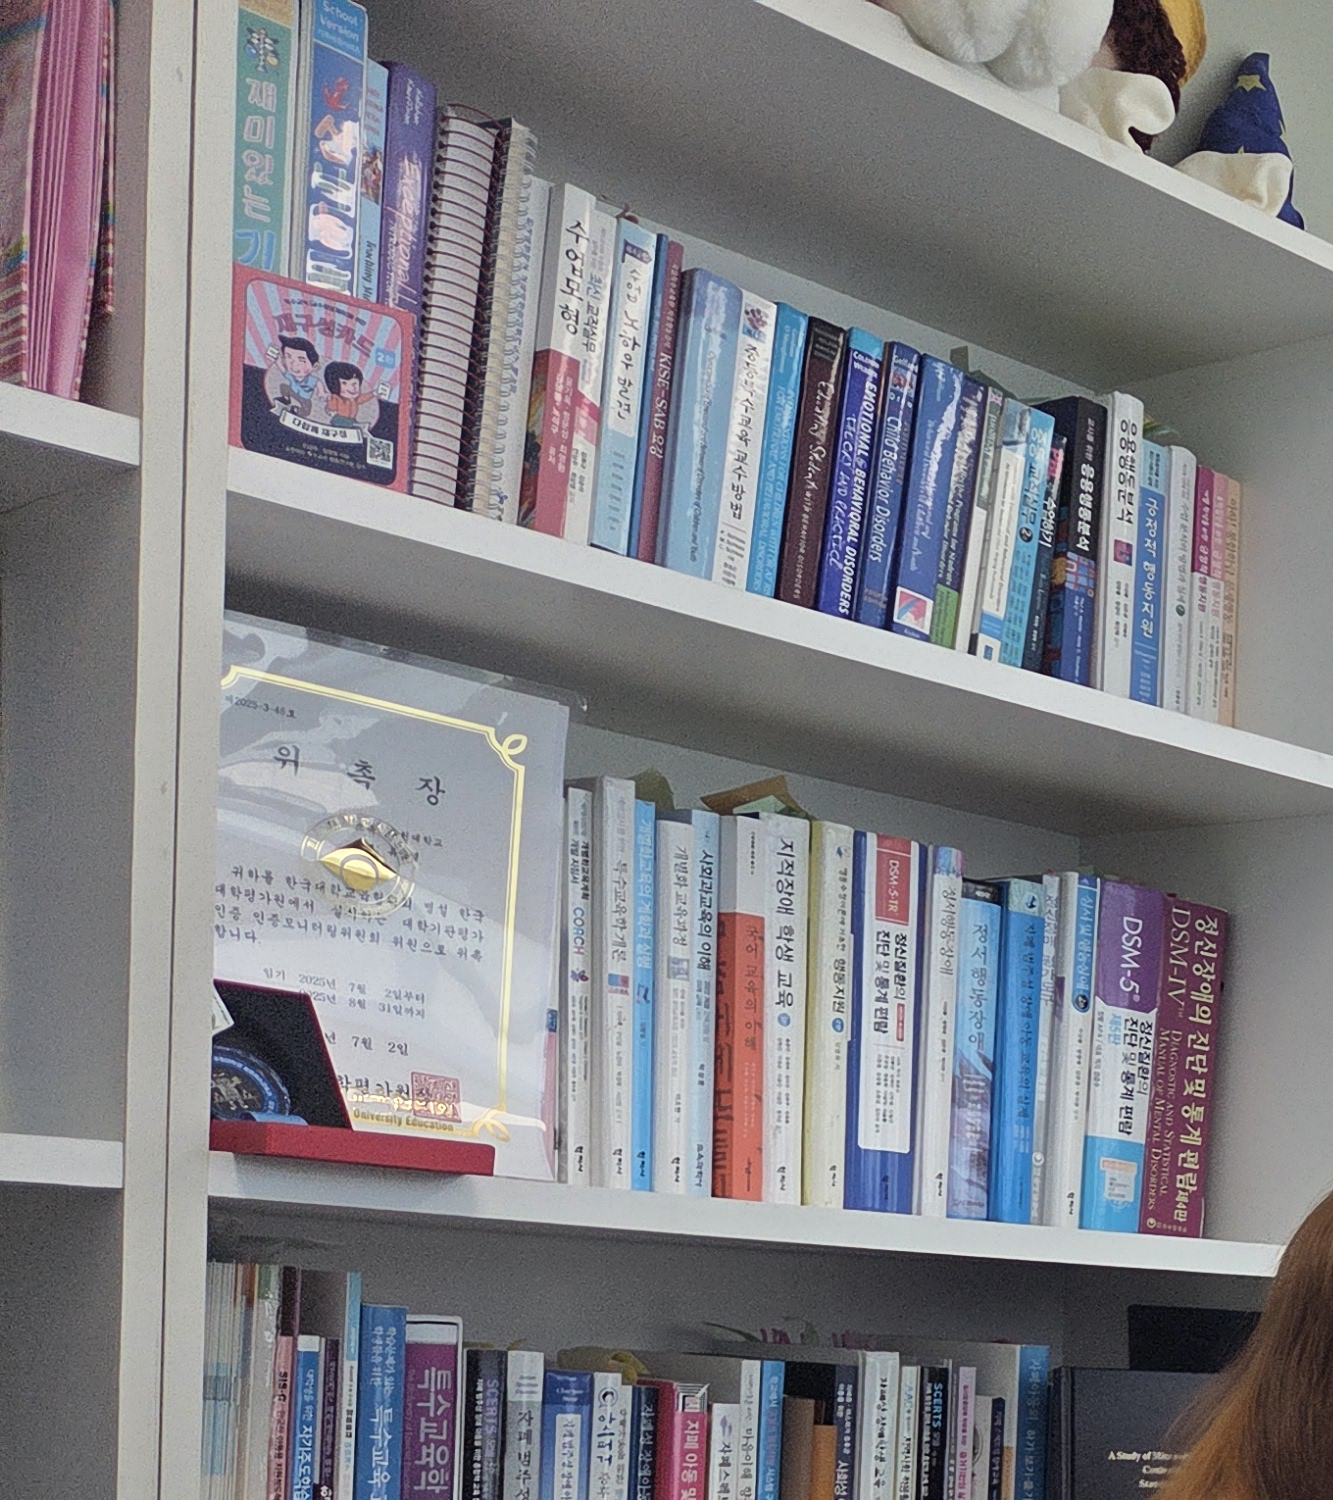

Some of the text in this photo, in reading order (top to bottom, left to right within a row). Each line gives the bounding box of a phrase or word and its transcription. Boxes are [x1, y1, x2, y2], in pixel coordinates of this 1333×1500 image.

[579, 301, 602, 354] 교직실무
[649, 350, 676, 431] KISE-SAB
[648, 431, 666, 459] 요강
[882, 416, 904, 449] Child
[837, 381, 877, 615] EMOTIONAL BEHAVIORAL DISORDERS
[875, 449, 899, 504] Behavior
[1110, 419, 1143, 525] 응용행동분석
[867, 505, 892, 563] Disorders
[1070, 463, 1100, 551] 응용행동분석
[697, 849, 713, 937] 사회과교육의
[571, 907, 586, 956] COACH
[775, 837, 795, 1008] 지적장애 학생 교육
[298, 973, 337, 989] 2025년
[697, 941, 712, 970] 이해
[874, 930, 890, 1034] 진단 및 통계 편람
[894, 933, 907, 999] 정신질환의
[1118, 915, 1144, 995] DSM-5
[1164, 907, 1191, 1007] DSM-IV
[1188, 914, 1220, 1026] 정신장애의
[832, 958, 846, 1013] 행동지원
[351, 1036, 373, 1051] 7월
[387, 1041, 409, 1057] 2일
[1135, 1020, 1153, 1095] 정신질환의
[1156, 1027, 1170, 1076] MANUAL
[1185, 1030, 1210, 1073] 진단
[1117, 1017, 1139, 1136] 진단 및 통계 편람
[1182, 1078, 1205, 1099] 및
[1151, 1098, 1166, 1144] MENTAL
[1158, 1029, 1183, 1197] DIAGNOSTIC AND STATISTICAL
[1178, 1101, 1204, 1146] 통계
[1175, 1149, 1200, 1192] 편람
[412, 1365, 453, 1495] 특수교육학
[485, 1379, 499, 1435] SCERTS
[931, 1382, 943, 1428] SCERTS
[367, 1405, 393, 1488] 특수교육
[681, 1419, 699, 1450] 자폐
[680, 1452, 698, 1485] 아동
[834, 1460, 849, 1496] 사회성
